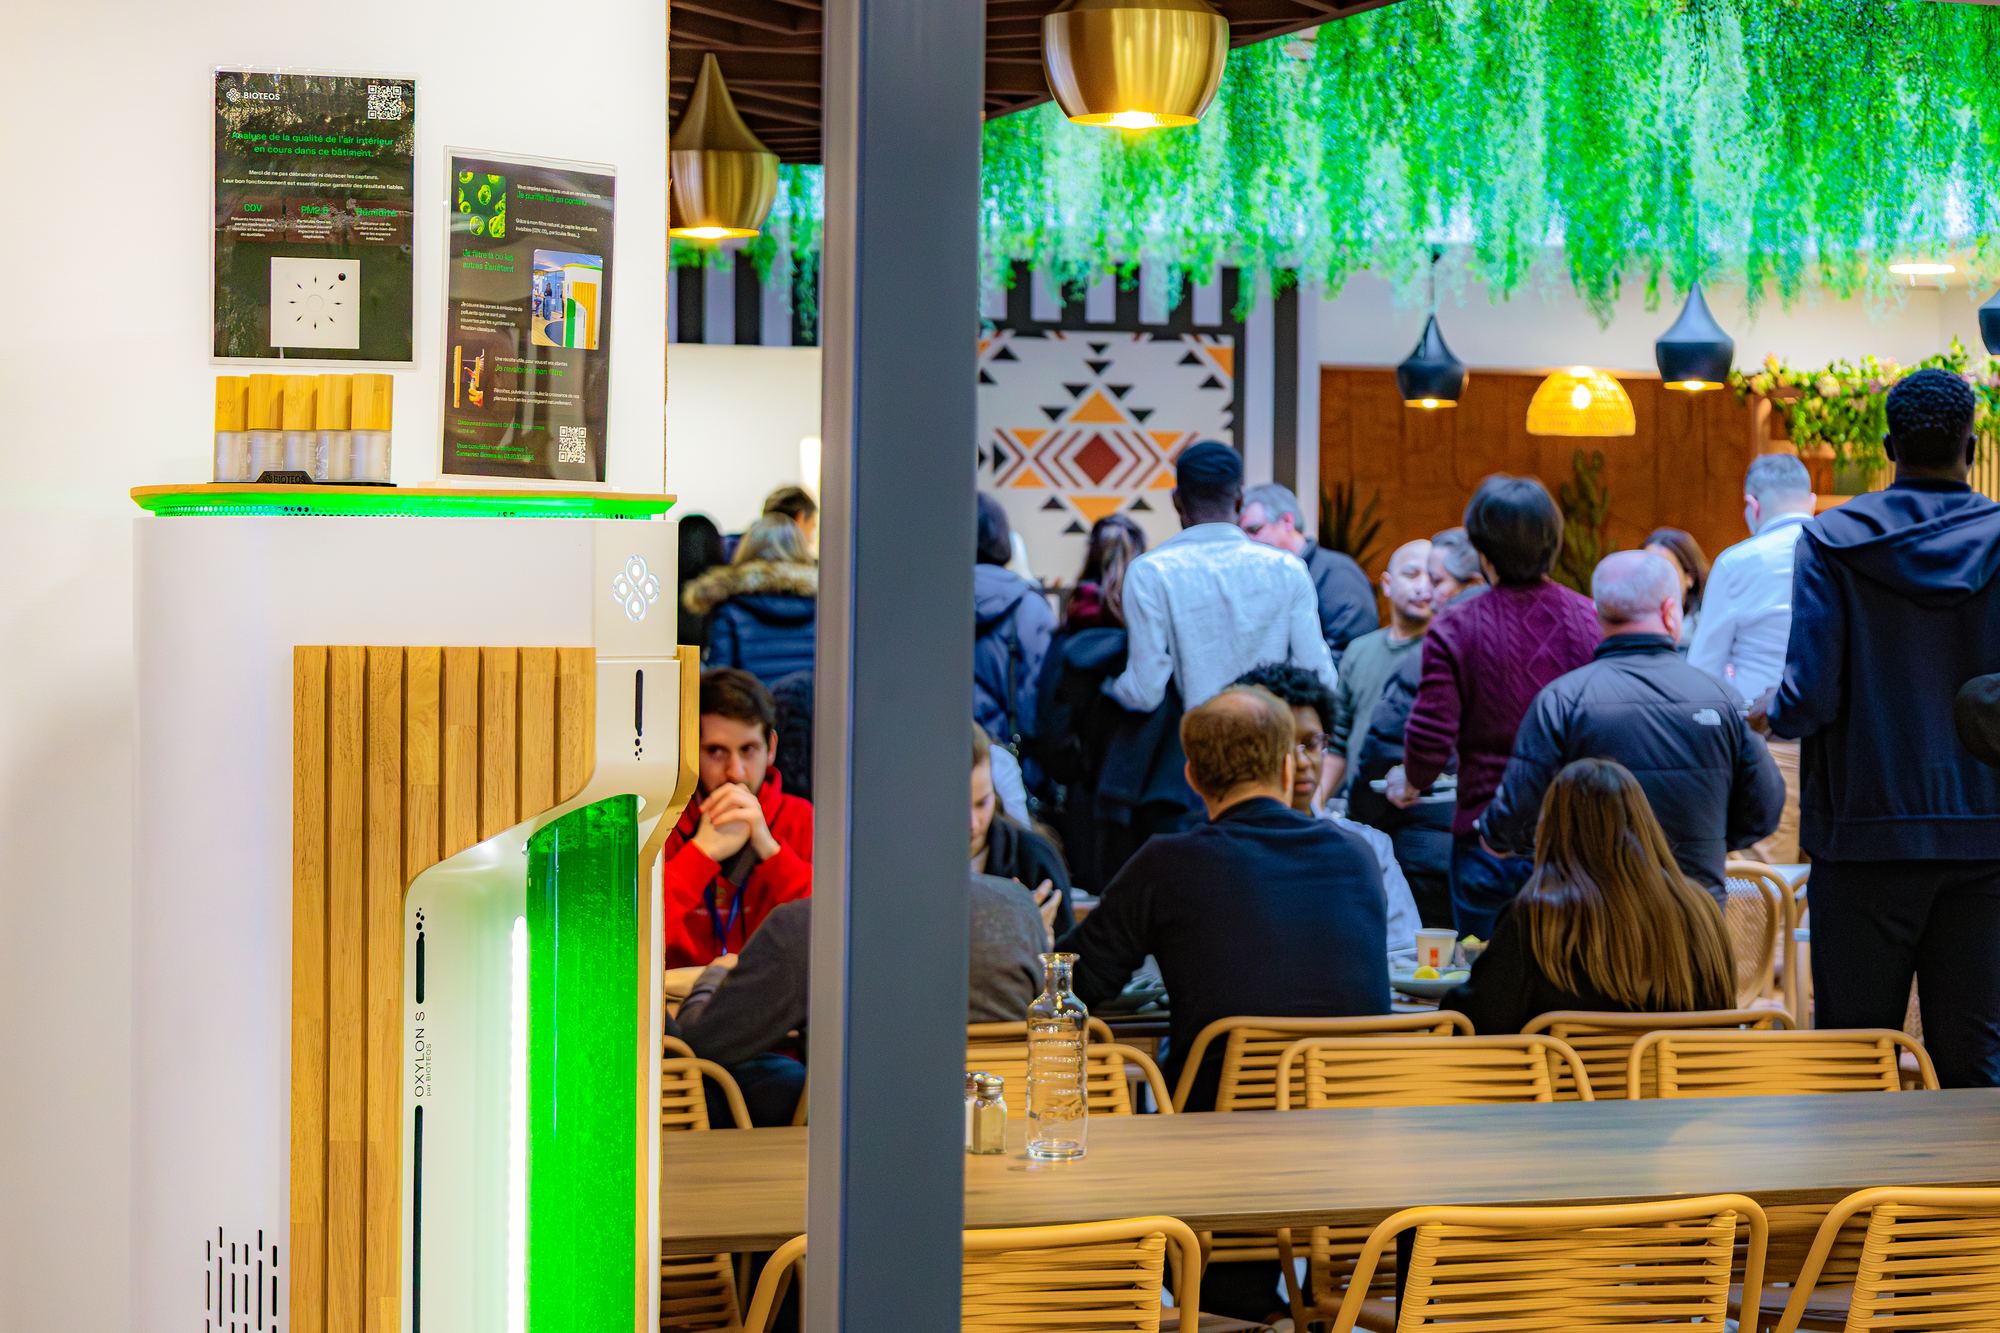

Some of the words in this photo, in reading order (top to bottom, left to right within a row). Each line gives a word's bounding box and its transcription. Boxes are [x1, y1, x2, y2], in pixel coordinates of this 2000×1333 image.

[244, 92, 280, 100] BIOTEOS
[232, 131, 267, 142] Analyse
[282, 132, 290, 141] la
[292, 134, 323, 143] qualité
[338, 136, 354, 144] l'air
[356, 136, 394, 145] intérieur
[332, 148, 374, 157] bâtiment.
[244, 204, 262, 212] COV
[415, 1011, 425, 1021] S
[414, 1028, 425, 1097] OXYLON
